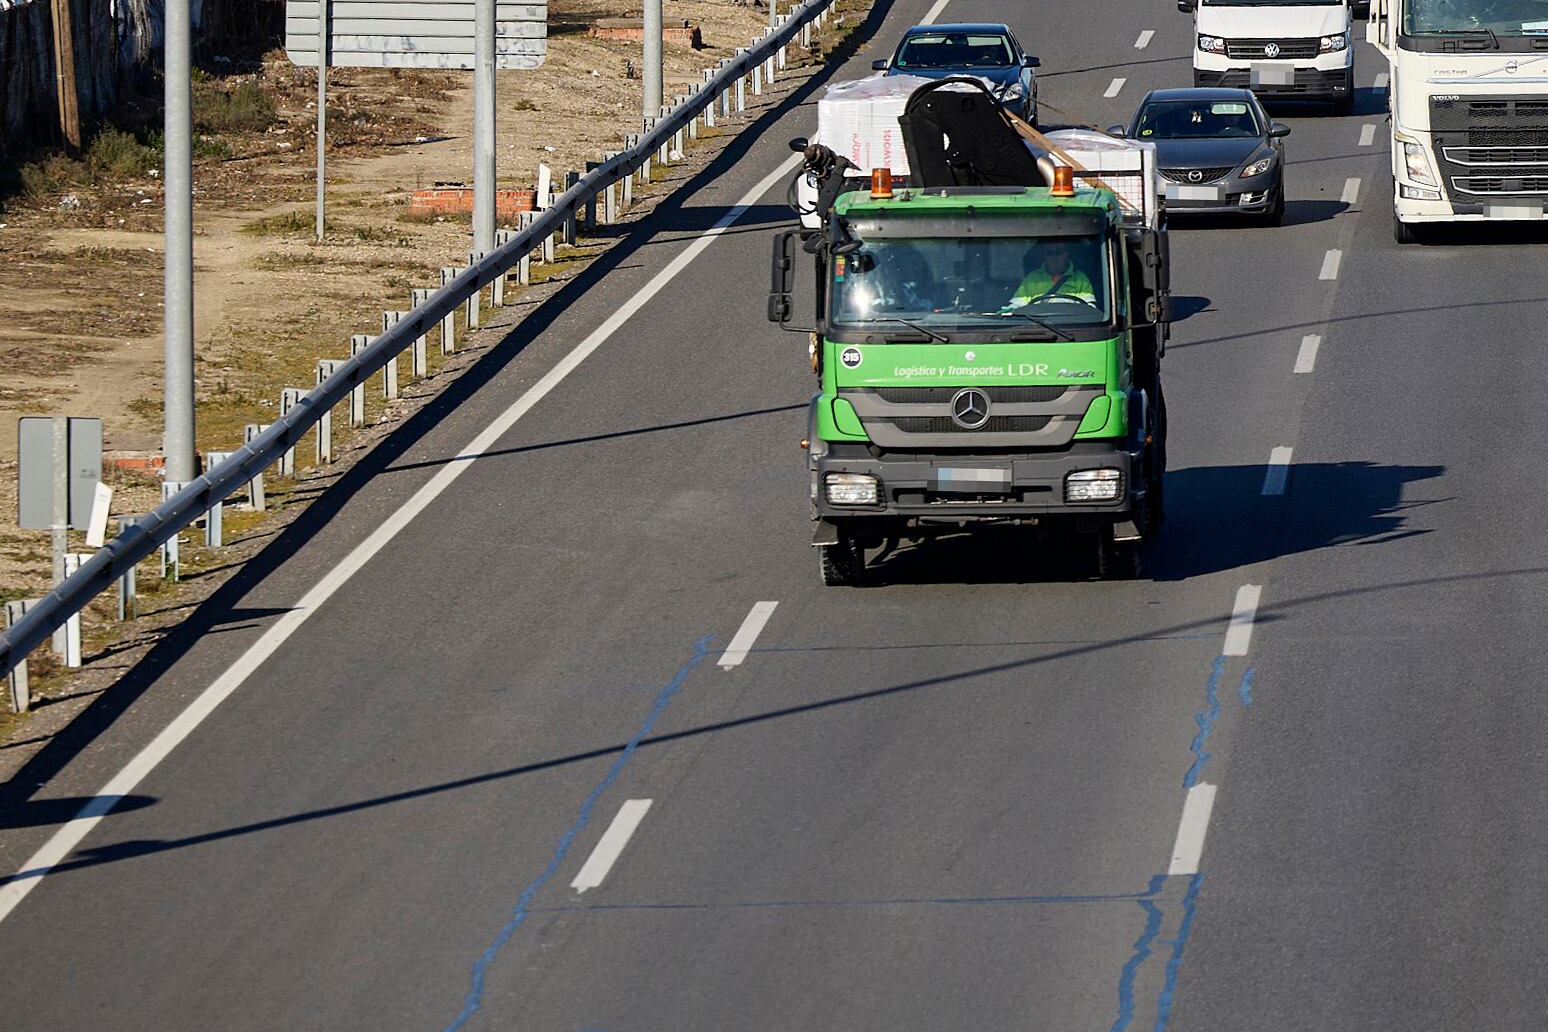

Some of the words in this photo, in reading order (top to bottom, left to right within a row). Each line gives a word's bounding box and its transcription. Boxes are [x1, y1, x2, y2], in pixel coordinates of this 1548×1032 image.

[843, 352, 860, 362] 315
[939, 368, 945, 377] y
[948, 365, 1004, 377] Transportes
[1008, 363, 1048, 376] LDR
